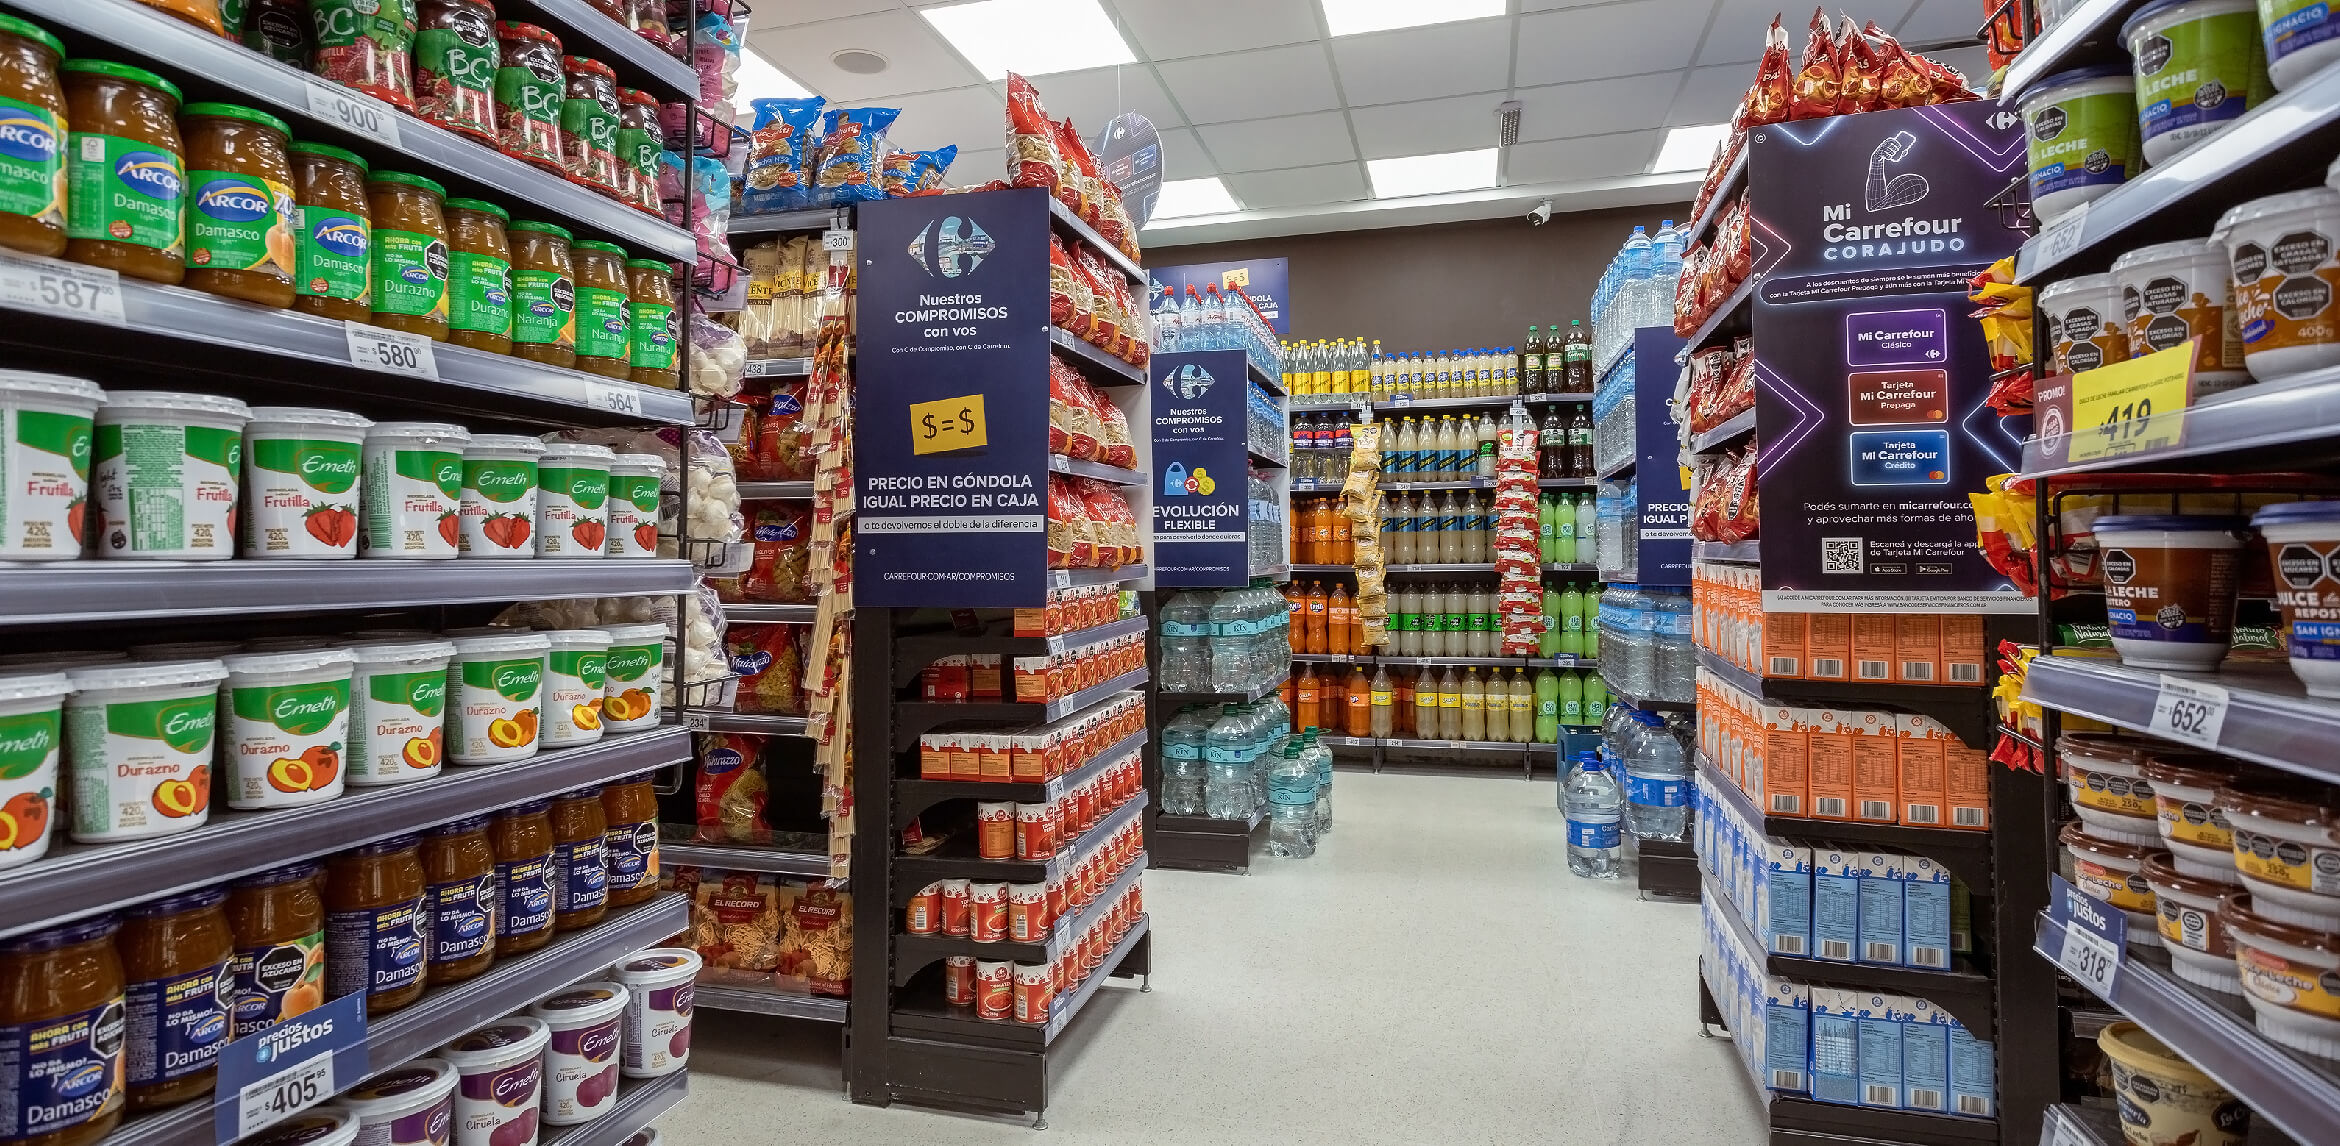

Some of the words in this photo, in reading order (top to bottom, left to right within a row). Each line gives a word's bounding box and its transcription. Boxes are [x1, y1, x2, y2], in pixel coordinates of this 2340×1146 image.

[447, 49, 491, 86] BC
[2146, 69, 2198, 96] LECHE
[522, 86, 559, 115] BC
[337, 100, 378, 131] 900
[2041, 138, 2088, 159] LECHE
[116, 158, 181, 193] ARCOR
[114, 193, 176, 221] Damasco
[197, 188, 269, 214] ARCOR
[1823, 203, 1851, 222] Mi
[196, 222, 260, 242] Damasco
[314, 223, 367, 249] ARCOR
[1823, 217, 1962, 243] Carrefour
[832, 236, 848, 247] 300
[1823, 238, 1965, 260] CORAJUDO
[2052, 226, 2075, 256] 652
[313, 253, 364, 274] Damasco
[39, 277, 101, 311] 587
[385, 280, 435, 299] Durazno
[919, 293, 982, 306] Nuestros
[471, 300, 509, 319] Durazno
[895, 306, 1008, 323] COMPROMISOS
[517, 313, 558, 328] Naranja
[592, 329, 625, 344] Naranja
[924, 327, 948, 337] con
[952, 325, 977, 336] vos
[1858, 331, 1873, 341] Mi
[1876, 329, 1935, 341] Carrefour
[2298, 325, 2334, 338] 400g
[1881, 340, 1912, 349] Clásico
[378, 344, 417, 368] 580
[747, 364, 762, 374] 438
[1881, 380, 1914, 391] Tarjeta
[2038, 385, 2066, 402] PROMO!
[608, 392, 633, 412] 564
[1860, 391, 1875, 401] Mi
[1876, 388, 1936, 400] Carrefour
[1170, 408, 1207, 416] Nuestros
[1881, 401, 1916, 410] Prepaga
[1155, 415, 1223, 425] COMPROMISOS
[2104, 398, 2151, 441] 419
[1883, 441, 1916, 451] Tarjeta
[1862, 451, 1876, 460] Mi
[1878, 449, 1938, 460] Carrefour
[302, 455, 357, 473] Emeth
[1884, 460, 1916, 470] Crédito
[478, 470, 527, 487] Emeth
[868, 476, 923, 490] PRECIO
[927, 475, 948, 489] EN
[952, 472, 1033, 489] GÓNDOLA
[27, 481, 74, 497] Frutilla
[572, 481, 607, 498] Emeth
[264, 495, 310, 508] Frutilla
[405, 501, 444, 513] Frutilla
[863, 495, 906, 509] IGUAL
[910, 494, 967, 508] PRECIO
[972, 494, 992, 507] EN
[996, 493, 1039, 507] CAJA
[1648, 503, 1689, 513] PRECIO
[1803, 502, 1836, 511] Podés
[1838, 502, 1880, 511] sumarte
[1882, 503, 1896, 511] en
[545, 509, 576, 521] Frutilla
[1153, 502, 1239, 518] EVOLUCIÓN
[881, 520, 933, 530] devolvemos
[933, 520, 942, 529] el
[943, 519, 969, 529] doble
[969, 520, 981, 529] de
[982, 519, 990, 529] la
[991, 519, 1038, 529] diferencia
[1164, 520, 1216, 530] FLEXIBLE
[1643, 515, 1678, 524] IGUAL
[1807, 516, 1813, 525] y
[1815, 514, 1874, 525] aprovechar
[1876, 514, 1898, 523] más
[1900, 513, 1935, 523] formas
[1938, 513, 1952, 522] de
[1870, 540, 1905, 549] Escaneá
[1954, 540, 1962, 548] la
[1870, 549, 1881, 557] de
[1883, 549, 1911, 558] Tarjeta
[1925, 549, 1965, 557] Carrefour
[2114, 587, 2159, 599] LECHE
[2296, 625, 2317, 635] SAN
[498, 670, 540, 687] Emeth
[275, 696, 336, 719] Emeth
[466, 705, 506, 716] Durazno
[689, 717, 704, 728] 234
[2171, 700, 2207, 735] 652
[377, 724, 423, 736] Durazno
[241, 743, 290, 755] Durazno
[117, 763, 180, 778] Durazno
[714, 899, 726, 908] EL
[726, 899, 760, 909] RECORD
[809, 907, 836, 917] RECORD
[2074, 900, 2107, 931] justos
[440, 935, 488, 954] Damasco
[262, 962, 291, 973] EXCESO
[2080, 946, 2107, 983] 318
[376, 961, 424, 985] Damasco
[258, 1022, 303, 1049] precios
[271, 1019, 333, 1063] justos
[165, 1036, 230, 1070] Damasco
[556, 1070, 587, 1083] Ciruela
[271, 1075, 318, 1114] 405
[316, 1067, 326, 1079] 95
[27, 1088, 111, 1125] Damasco
[466, 1117, 501, 1131] Ciruela
